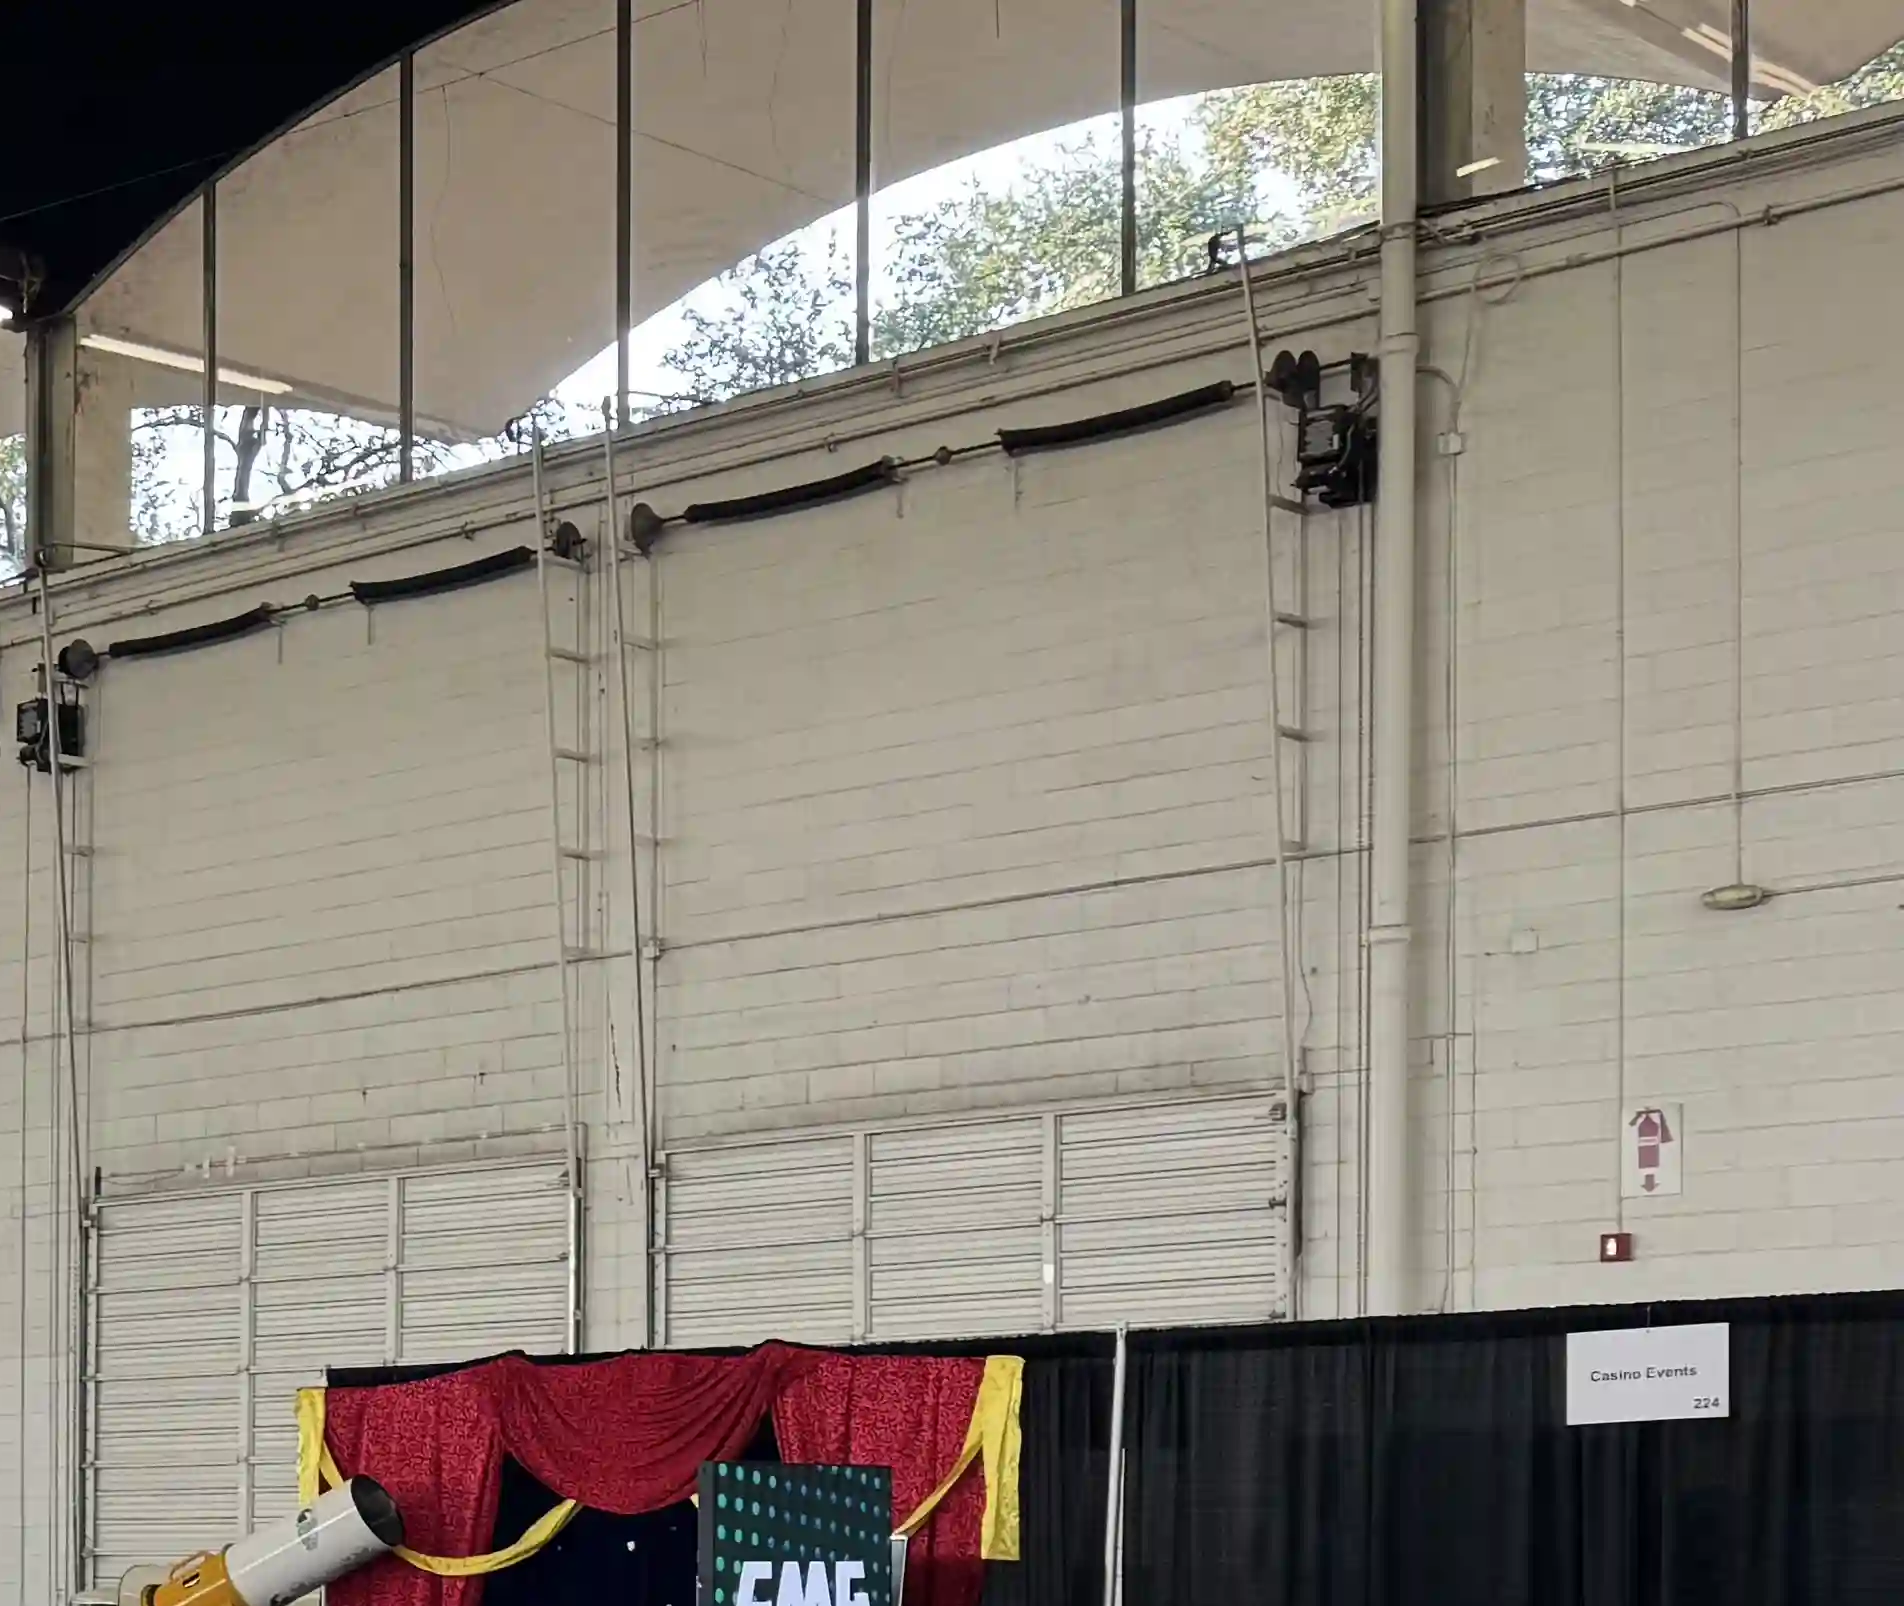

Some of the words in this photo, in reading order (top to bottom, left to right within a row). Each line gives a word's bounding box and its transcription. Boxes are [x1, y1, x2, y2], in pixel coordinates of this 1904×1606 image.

[1589, 1369, 1642, 1382] Casino
[1646, 1366, 1698, 1380] Events
[1693, 1397, 1720, 1410] 224
